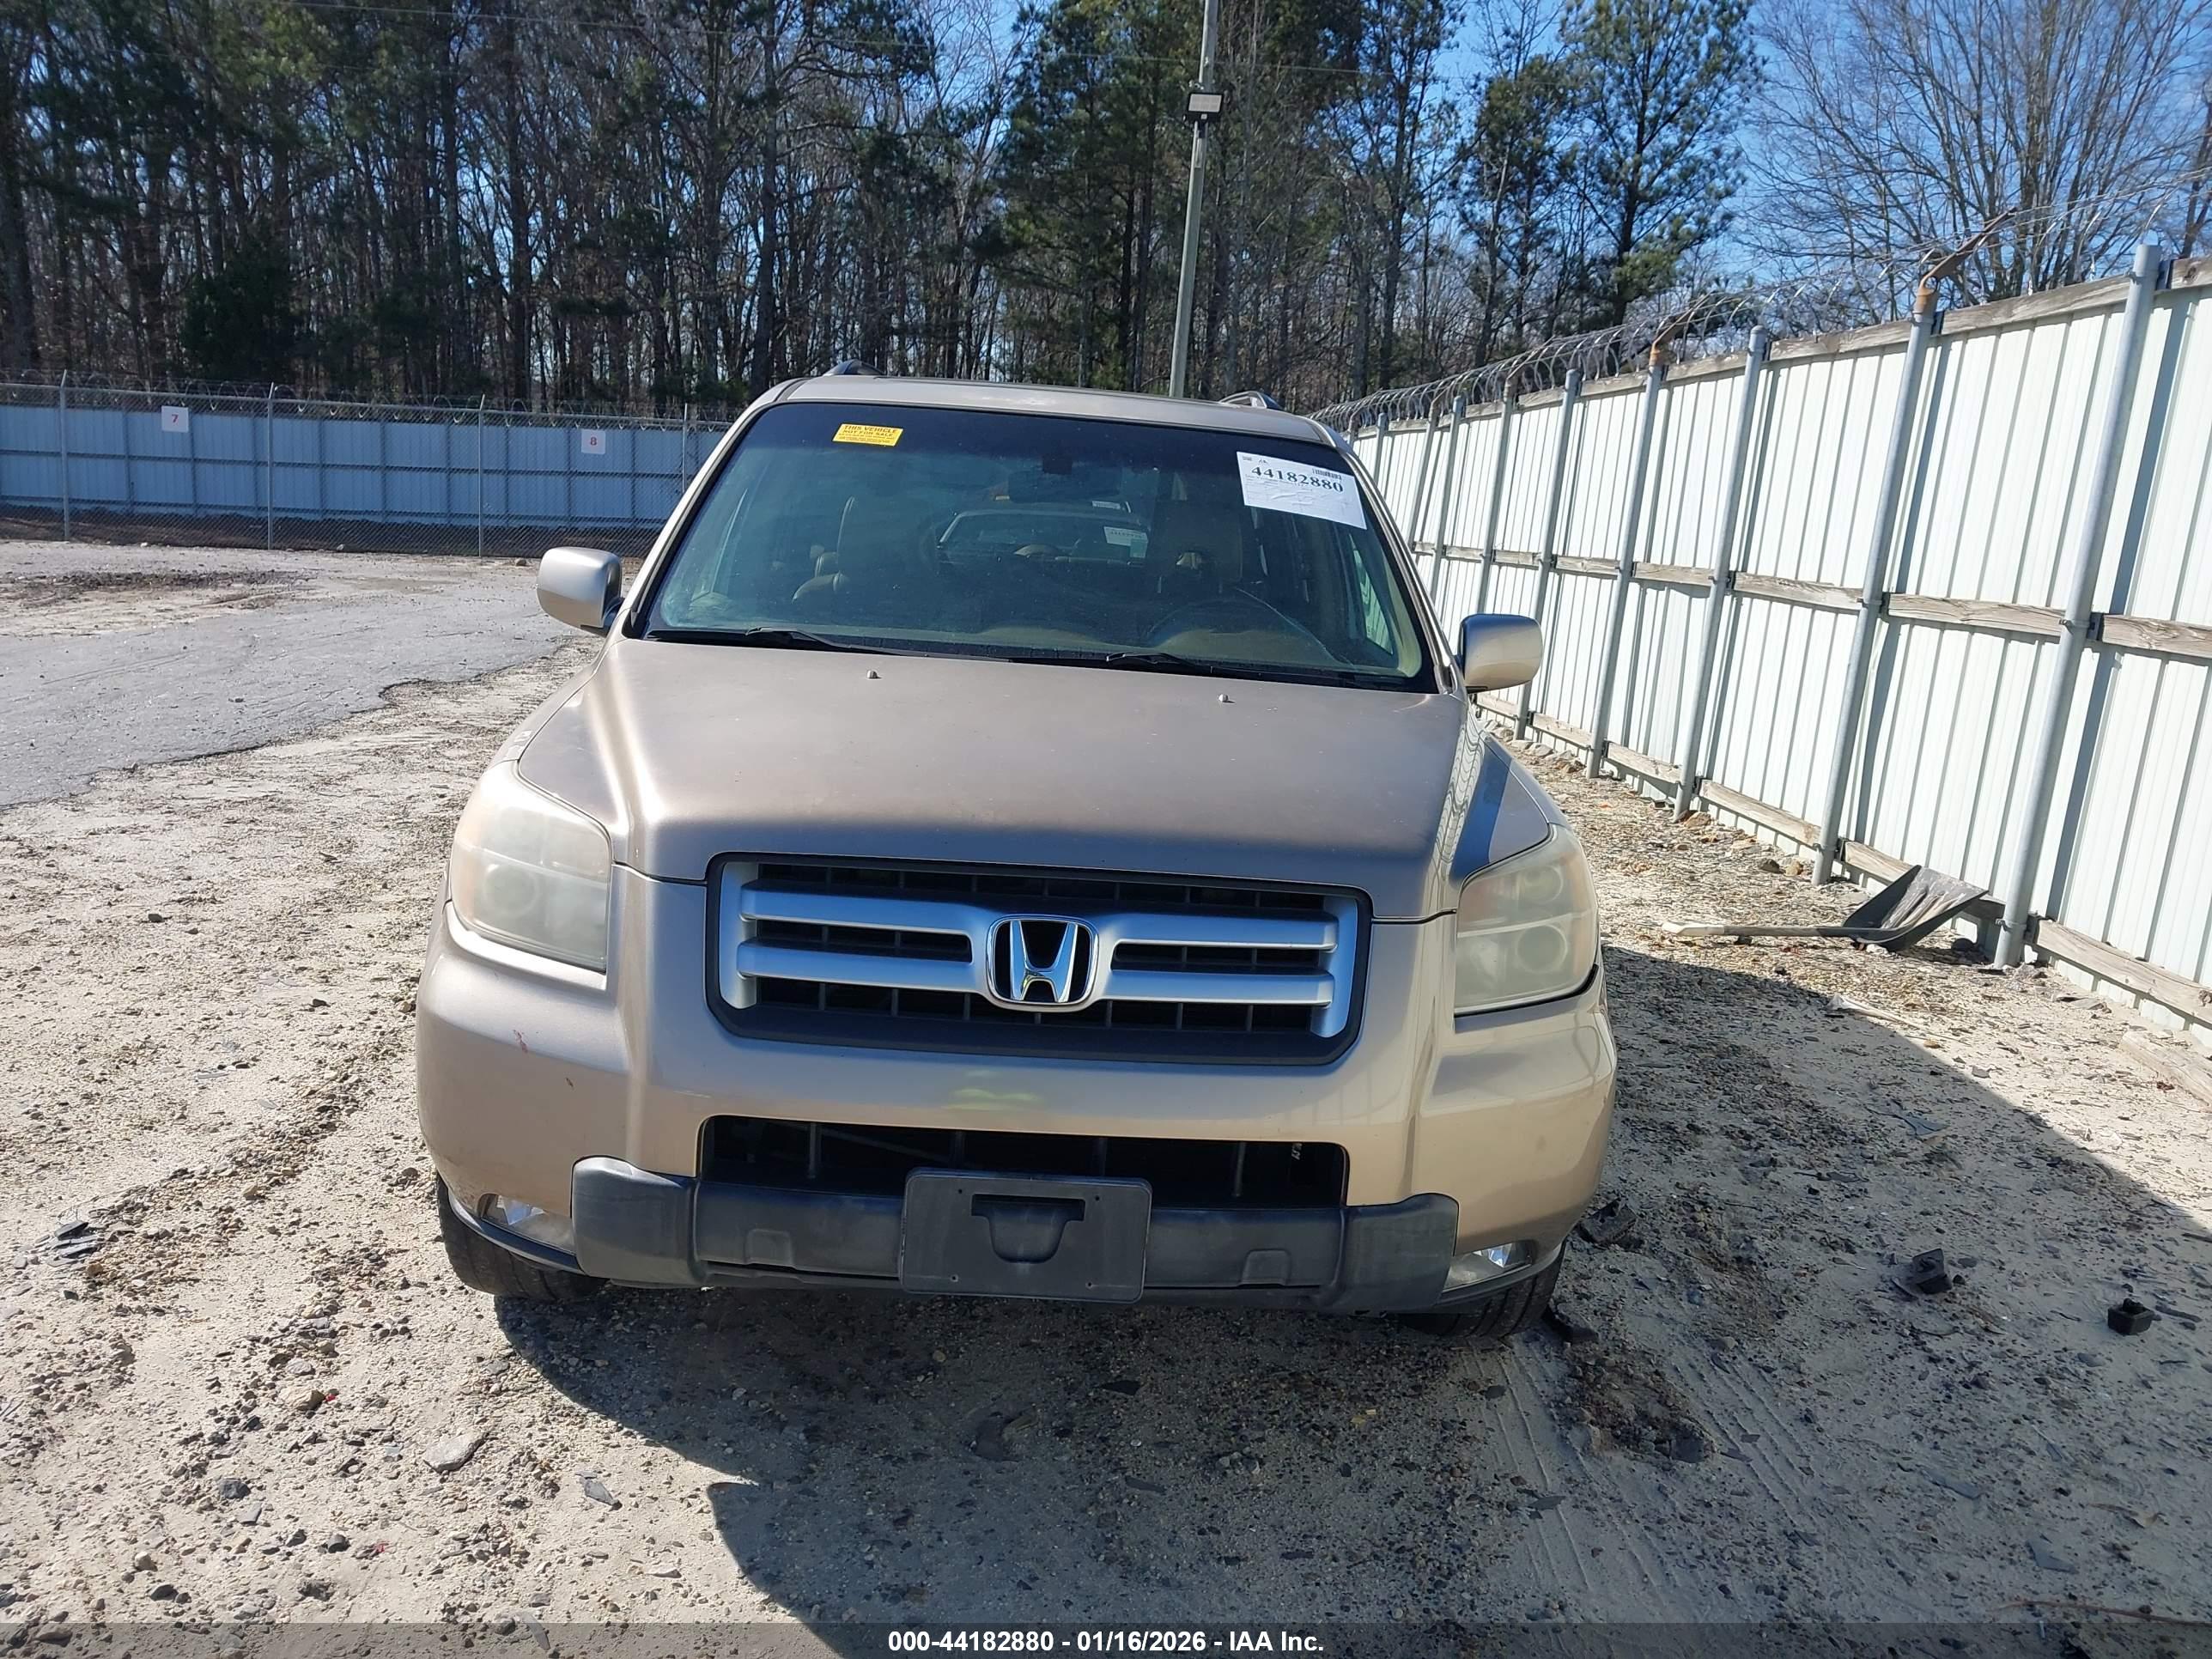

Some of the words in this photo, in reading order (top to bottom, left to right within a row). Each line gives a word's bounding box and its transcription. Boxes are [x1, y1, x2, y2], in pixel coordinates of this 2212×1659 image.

[172, 414, 179, 423] 7
[590, 436, 598, 446] 8
[1251, 466, 1344, 493] 44182880
